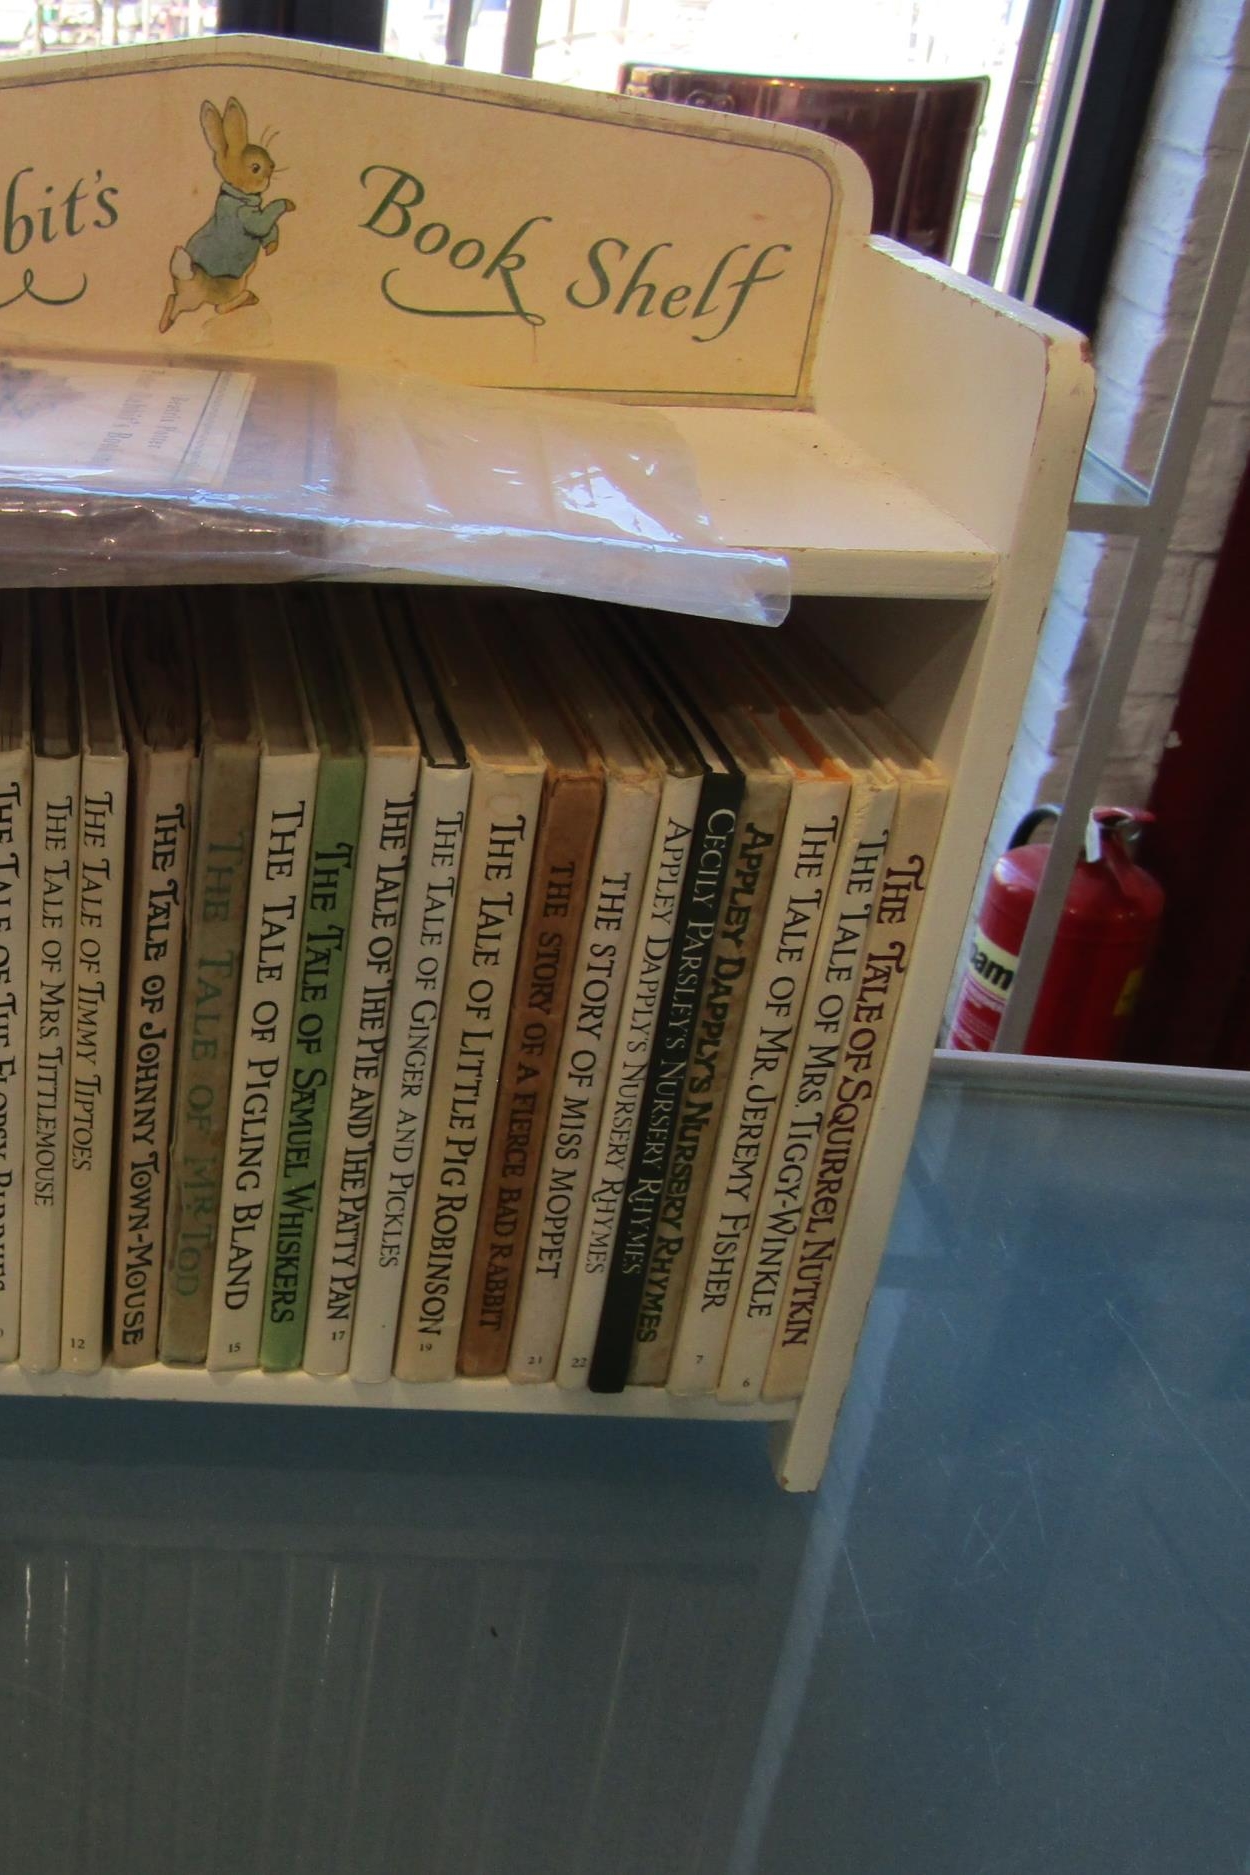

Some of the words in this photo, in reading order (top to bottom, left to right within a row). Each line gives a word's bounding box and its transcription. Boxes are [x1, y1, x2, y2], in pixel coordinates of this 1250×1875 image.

[357, 164, 553, 326] Book
[565, 236, 792, 343] Shelf
[45, 796, 73, 851] THE
[83, 791, 114, 848] THE
[152, 803, 185, 872] THE
[265, 800, 306, 881] THE
[379, 791, 416, 852] THE
[431, 811, 465, 868] THE
[484, 814, 527, 882] THE
[692, 808, 736, 905] CECILY
[794, 815, 838, 880] THE
[42, 859, 70, 929] TALE
[80, 858, 110, 928] TALE
[202, 831, 245, 922] THE
[310, 842, 354, 912] THE
[371, 854, 408, 930] TALE
[542, 861, 575, 918] THE
[651, 817, 693, 926] APPLEY
[719, 822, 775, 949] APPLEY
[846, 829, 889, 895] THE
[876, 854, 925, 925] THE
[143, 878, 179, 962] TALE
[256, 895, 296, 983] TALE
[420, 876, 455, 947] TALE
[472, 891, 514, 968] TALE
[593, 872, 631, 932] THE
[776, 889, 822, 965] TALE
[40, 940, 62, 974] OF
[79, 938, 101, 974] OF
[301, 923, 346, 1001] TALE
[367, 936, 394, 974] OF
[415, 957, 439, 990] OF
[528, 932, 563, 1016] STORY
[825, 903, 872, 983] TALE
[141, 974, 165, 1014] OF
[191, 951, 235, 1060] TALE
[359, 979, 394, 1032] THE
[465, 979, 494, 1020] OF
[576, 943, 617, 1041] STORY
[626, 935, 671, 1054] DAPPLY'S
[665, 919, 716, 1050] PARSLEY'S
[765, 976, 796, 1017] OF
[814, 994, 844, 1034] OF
[853, 941, 906, 1023] TALE
[75, 981, 105, 1066] TIMMY
[251, 1000, 279, 1043] OF
[297, 1013, 324, 1055] OF
[353, 1036, 387, 1081] PIE
[401, 1000, 438, 1100] GINGER
[520, 1022, 548, 1057] OF
[688, 955, 746, 1095] DAPPLY'S
[844, 1027, 877, 1073] OF
[133, 1021, 167, 1145] JOHNNY
[449, 1029, 493, 1130] LITTLE
[516, 1061, 541, 1086] A
[568, 1050, 597, 1089] OF
[34, 1046, 63, 1207] TITTLEMOUSE
[72, 1073, 101, 1172] TIPTOES
[185, 1084, 214, 1133] OF
[236, 1056, 280, 1193] PIGLING
[283, 1067, 327, 1178] SAMUEL
[347, 1086, 375, 1140] AND
[392, 1109, 418, 1163] AND
[501, 1091, 537, 1178] FIERCE
[555, 1096, 590, 1161] MISS
[605, 1061, 648, 1170] NURSERY
[642, 1058, 686, 1172] NURSERY
[726, 1084, 778, 1202] JEREMY
[340, 1139, 376, 1192] THE
[440, 1136, 478, 1188] PIG
[660, 1101, 711, 1231] NURSERY
[805, 1075, 872, 1233] SQUIRREL
[122, 1150, 160, 1345] TOWN-MOUSE
[332, 1195, 368, 1268] PATTY
[379, 1171, 415, 1269] PICKLES
[494, 1187, 523, 1238] BAD
[535, 1168, 578, 1279] MOPPET
[584, 1177, 625, 1275] RHYMES
[621, 1178, 663, 1276] RHYMES
[746, 1112, 823, 1318] TIGGY-WINKLE
[175, 1223, 216, 1297] TOD
[225, 1200, 263, 1311] BLAND
[270, 1180, 317, 1324] WHISKERS
[419, 1193, 468, 1336] ROBINSON
[480, 1242, 513, 1331] RABBIT
[636, 1235, 683, 1343] RHYMES
[701, 1213, 751, 1313] FISHER
[327, 1274, 358, 1321] PAN
[782, 1237, 836, 1348] NUTKIN
[69, 1337, 86, 1350] 12
[228, 1342, 241, 1353] 15
[331, 1330, 345, 1341] 17
[570, 1357, 587, 1368] 22
